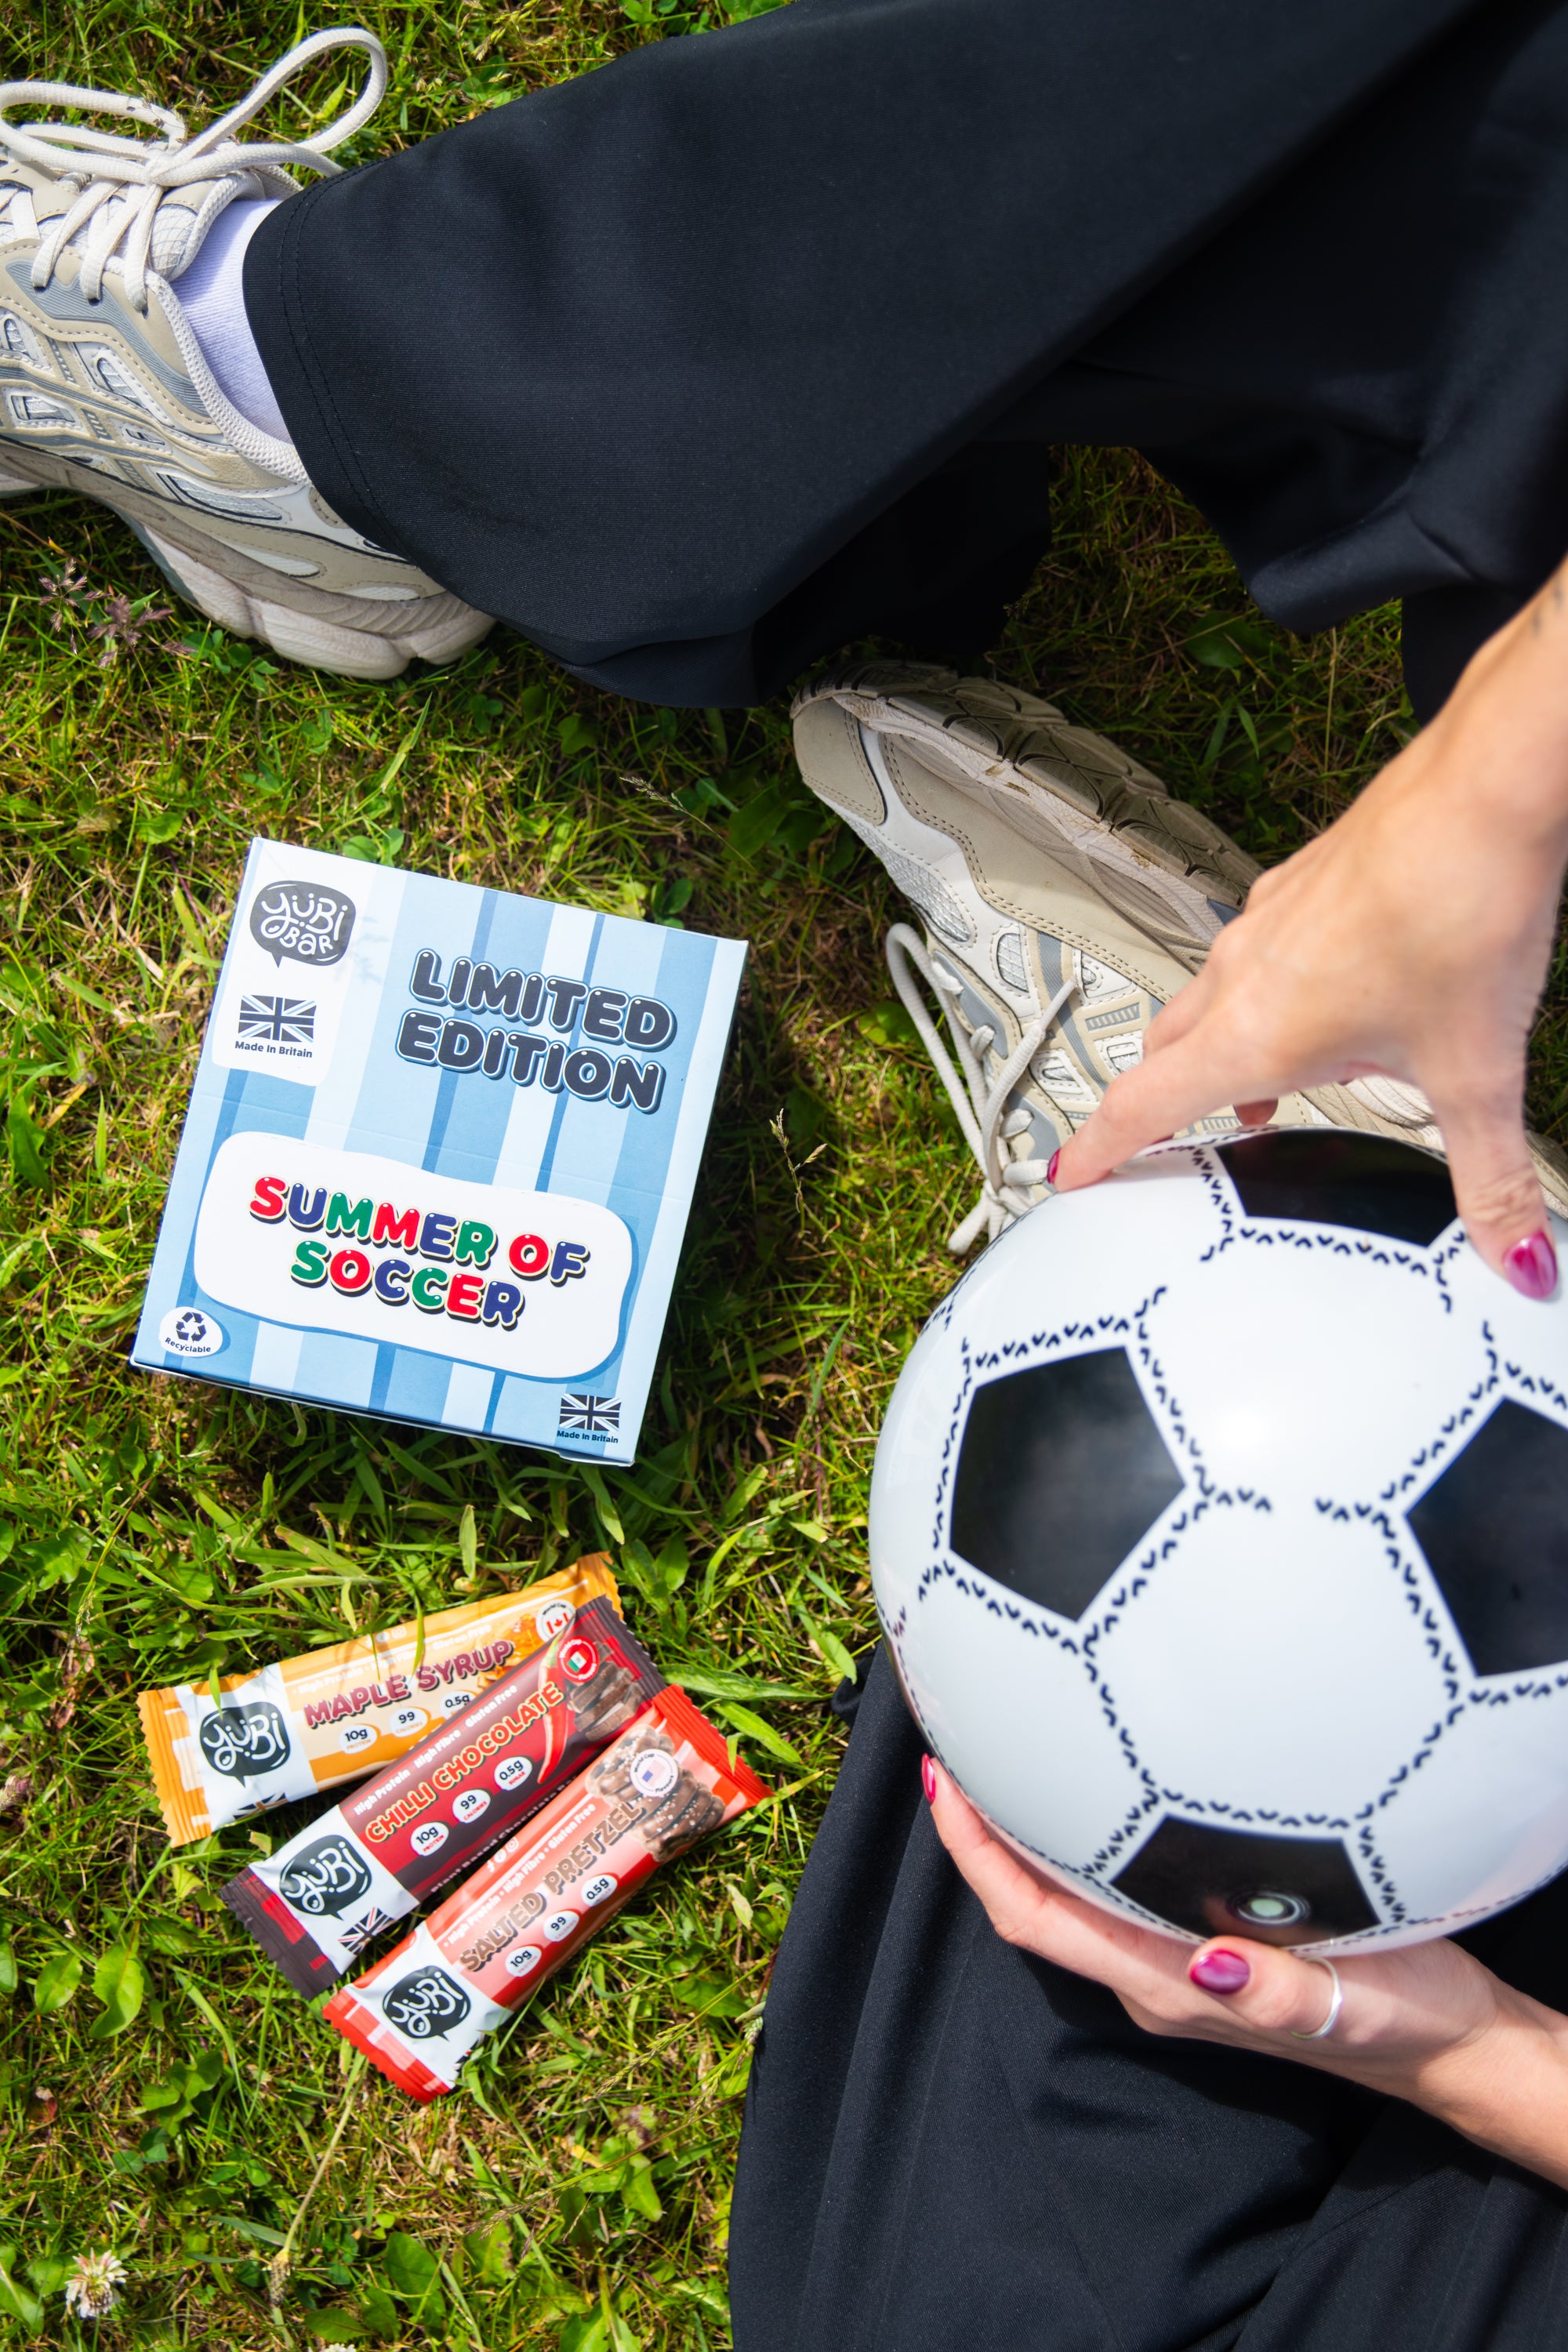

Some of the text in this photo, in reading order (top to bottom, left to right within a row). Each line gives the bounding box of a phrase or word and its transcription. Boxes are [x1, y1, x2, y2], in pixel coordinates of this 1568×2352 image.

[409, 948, 677, 1053] LIMITED
[235, 1041, 313, 1058] Made In Britain
[395, 1008, 666, 1115] EDITION
[249, 1174, 590, 1287] SUMMER OF
[290, 1238, 525, 1331] SOCCER
[165, 1337, 212, 1353] Recyclable
[557, 1430, 619, 1444] Made In Britain
[303, 1639, 516, 1730] MAPLE SYRUP
[345, 1694, 470, 1742] 10g 99 0.5g
[347, 1739, 372, 1750] PROTEIN
[354, 1685, 518, 1816] High Protein High Fibre Gluten Free
[365, 1681, 564, 1842] CHILLI CHOCOLATE
[416, 1759, 524, 1844] 10g 99 0.5g
[423, 1770, 526, 1853] PROTEIN CALORIES SUGAR
[447, 1803, 597, 1944] High Protein High Fibre Gluten Free
[459, 1799, 647, 1973] SALTED PRETZEL
[510, 1876, 609, 1968] 10g 99 0.5g
